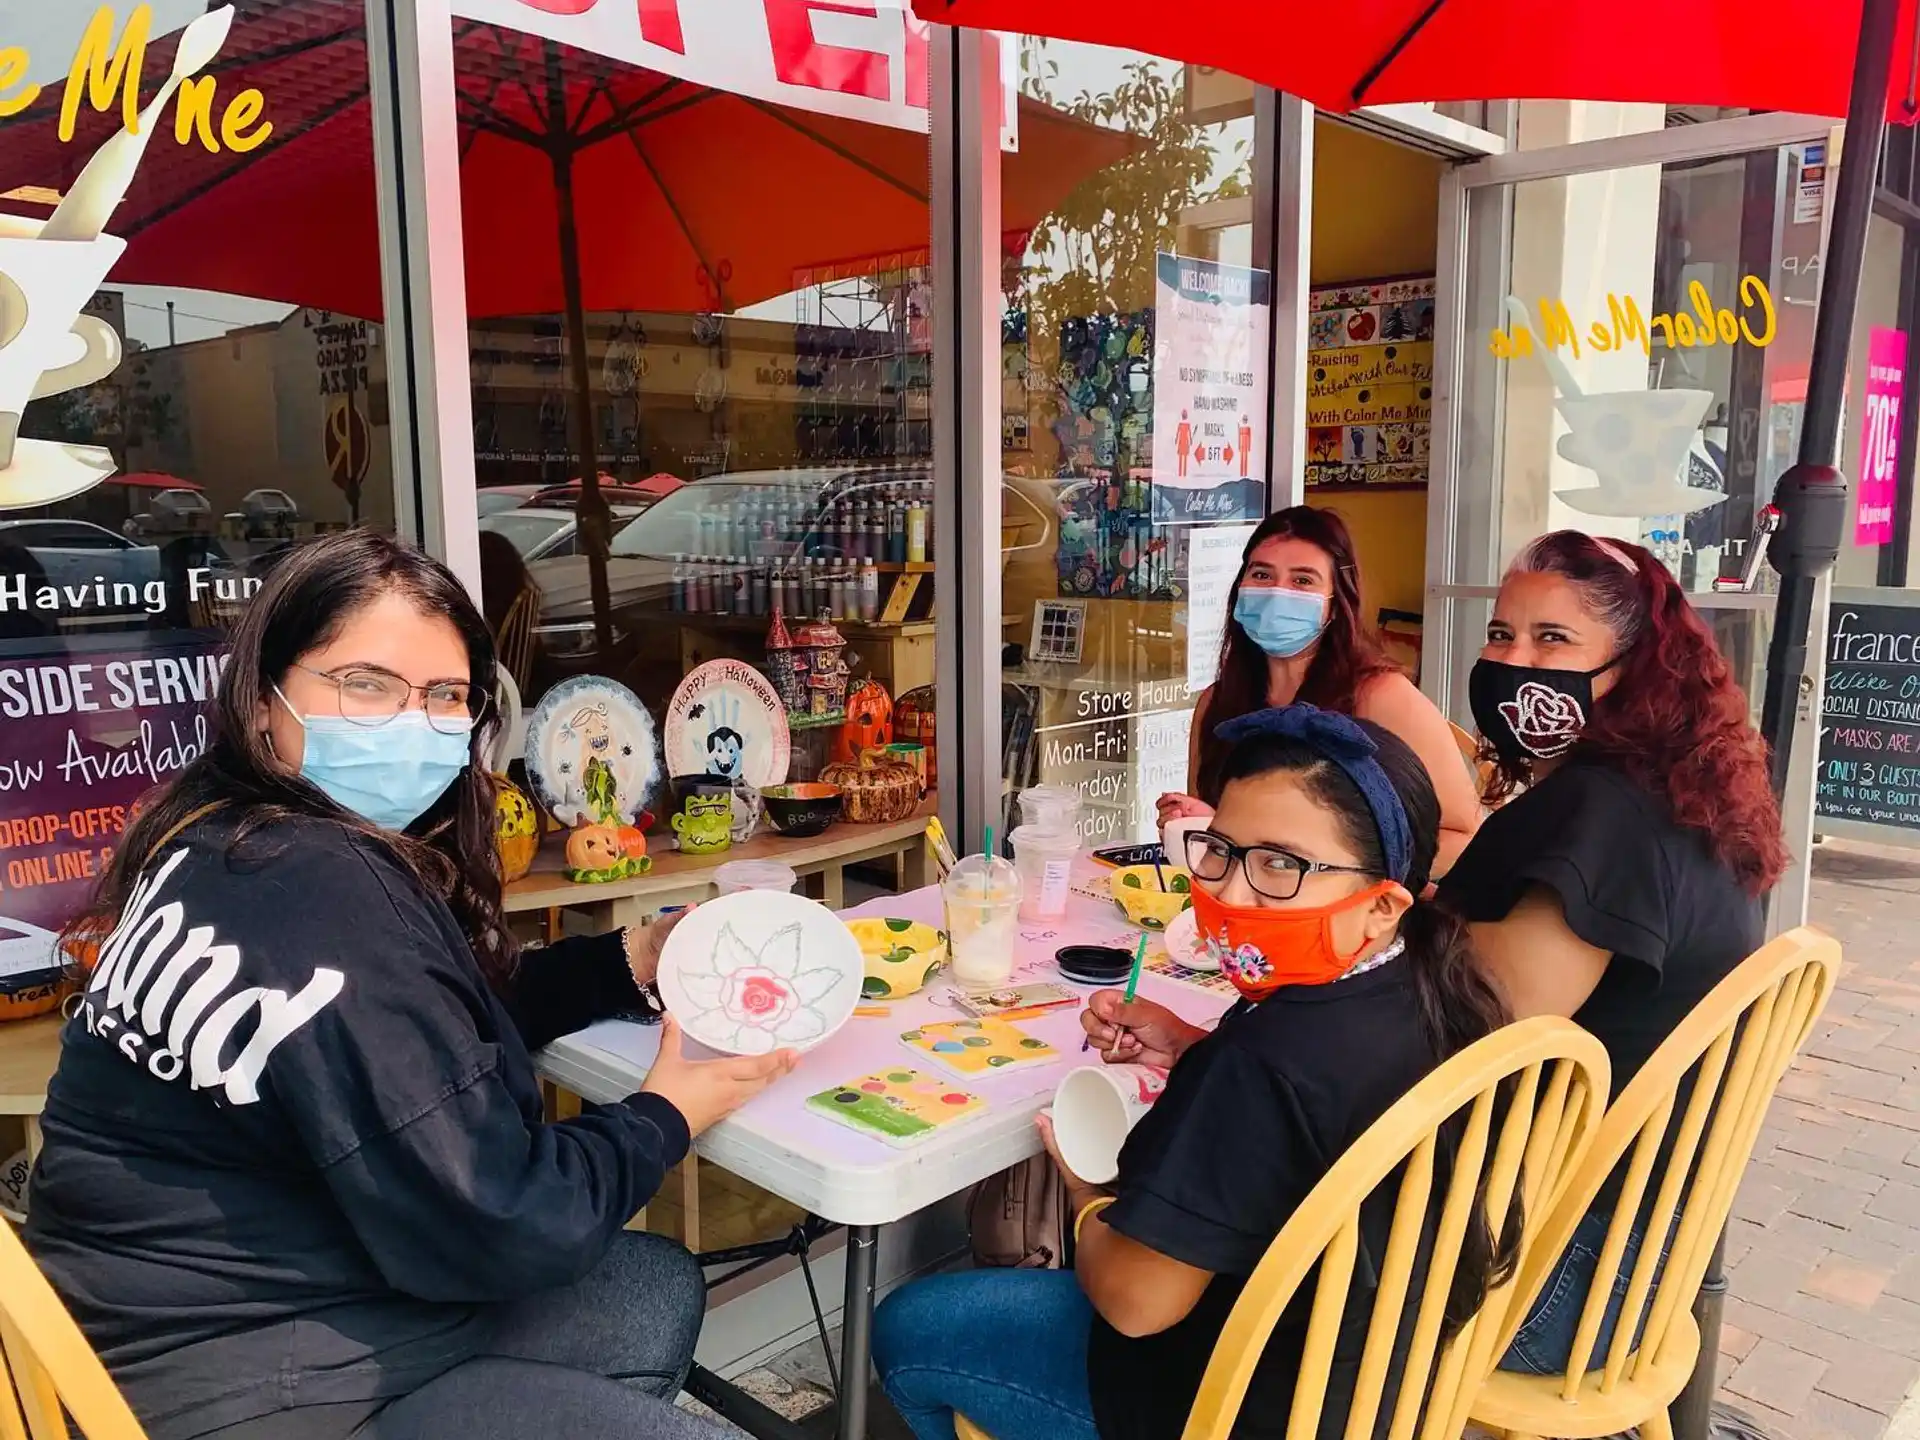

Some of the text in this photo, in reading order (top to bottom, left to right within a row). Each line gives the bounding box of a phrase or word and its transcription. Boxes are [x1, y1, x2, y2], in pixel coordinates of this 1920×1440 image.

[1204, 422, 1225, 437] MASKS
[1308, 408, 1341, 424] With
[1343, 407, 1377, 422] Color
[1381, 406, 1403, 420] Me
[0, 567, 263, 613] Having Fun
[673, 666, 776, 716] Happy Halloween
[1077, 680, 1191, 717] Store Hours
[56, 714, 207, 785] Availabl
[1043, 729, 1128, 769] Mon-Fri:
[1834, 727, 1913, 753] MASKS ARE
[1828, 760, 1858, 781] ONLY
[1861, 762, 1876, 781] 3
[1859, 788, 1881, 802] OUR
[1074, 808, 1122, 840] nday:
[8, 850, 97, 889] ONLINE
